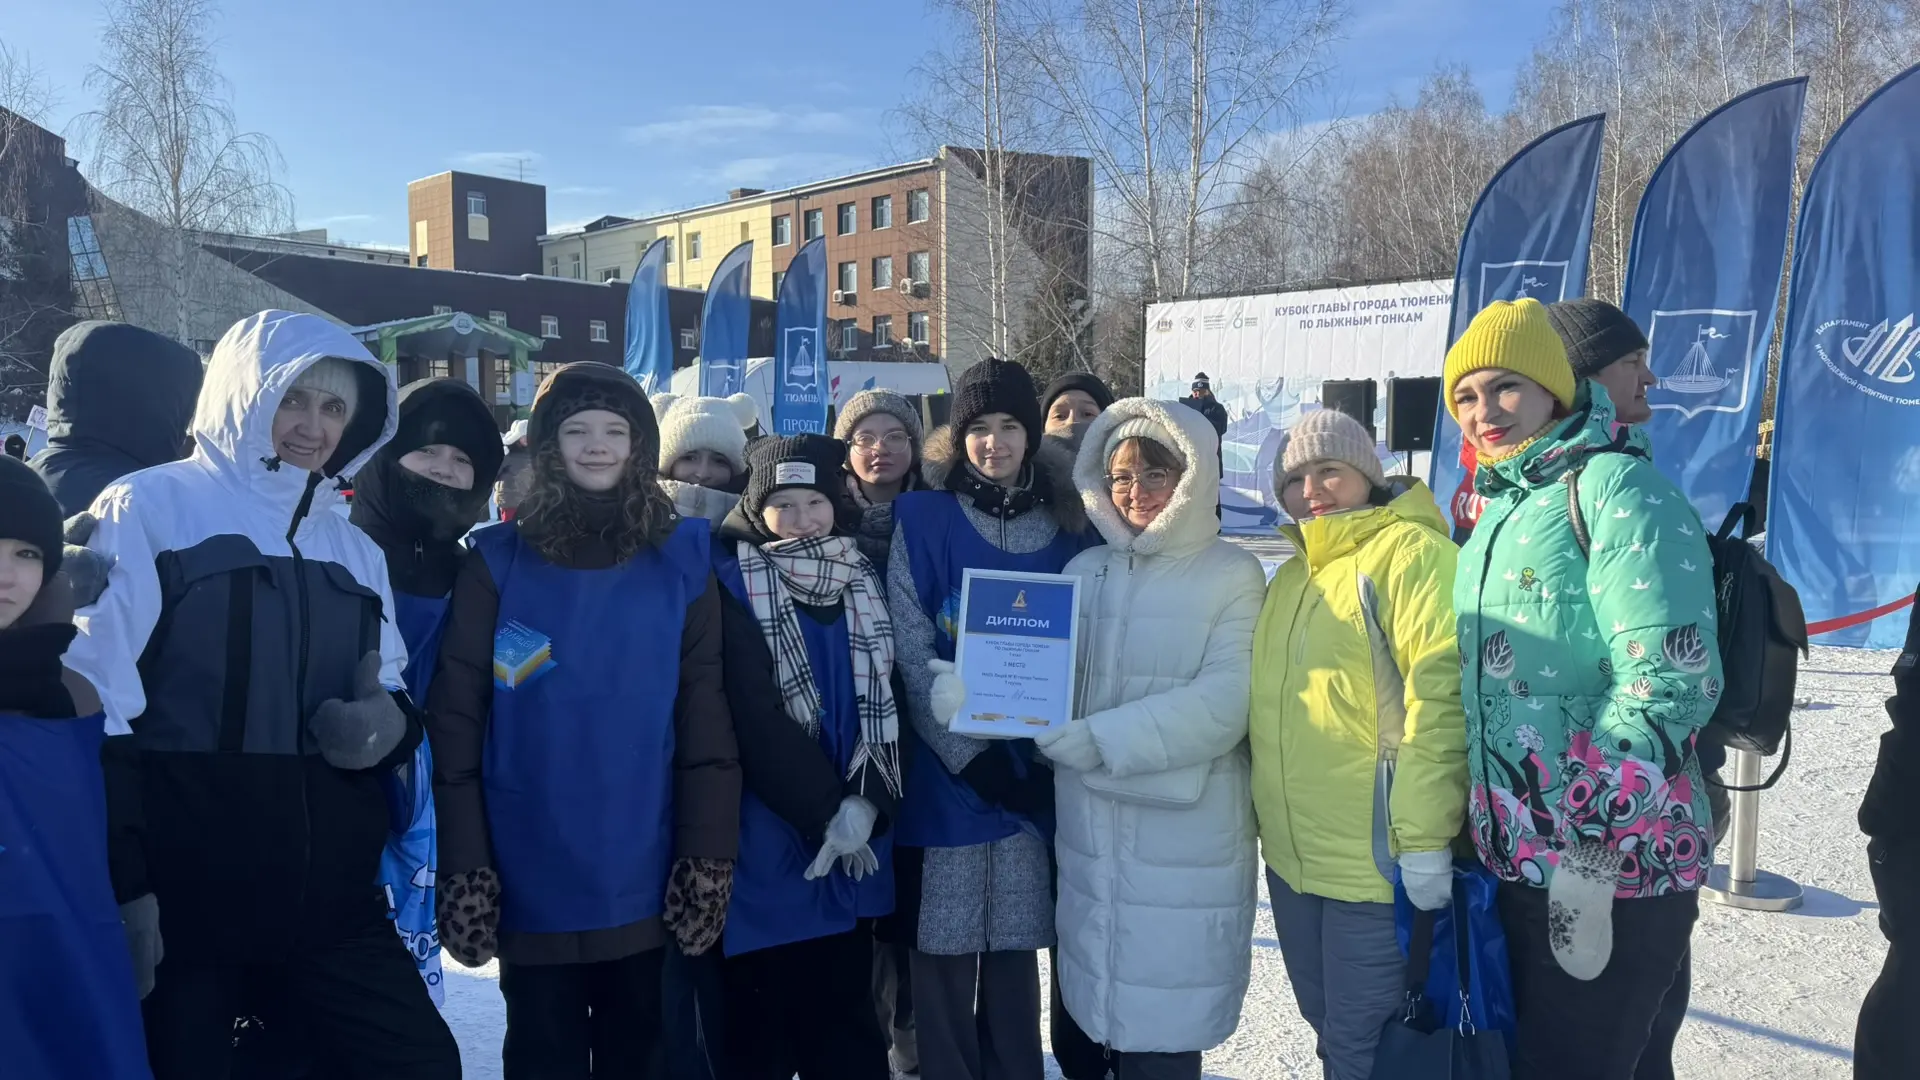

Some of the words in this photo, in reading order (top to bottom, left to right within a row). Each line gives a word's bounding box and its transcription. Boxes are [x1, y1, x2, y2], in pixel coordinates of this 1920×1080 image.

[1275, 305, 1309, 317] КУБОК
[1312, 302, 1350, 314] ГЛАВЫ
[1353, 298, 1397, 312] ГОРОДА
[1401, 294, 1453, 308] ТЮМЕНИ
[1299, 318, 1314, 330] ПО
[1316, 315, 1372, 329] ЛЫЖНЫМ
[1375, 311, 1423, 325] ГОНКАМ
[1815, 319, 1871, 336] ДЕПАРТАМЕНТ
[1816, 348, 1859, 387] МОЛОДЕЖНОЙ
[1857, 384, 1895, 404] ПОЛИТИКЕ
[985, 615, 1050, 629] ДИПЛОМ
